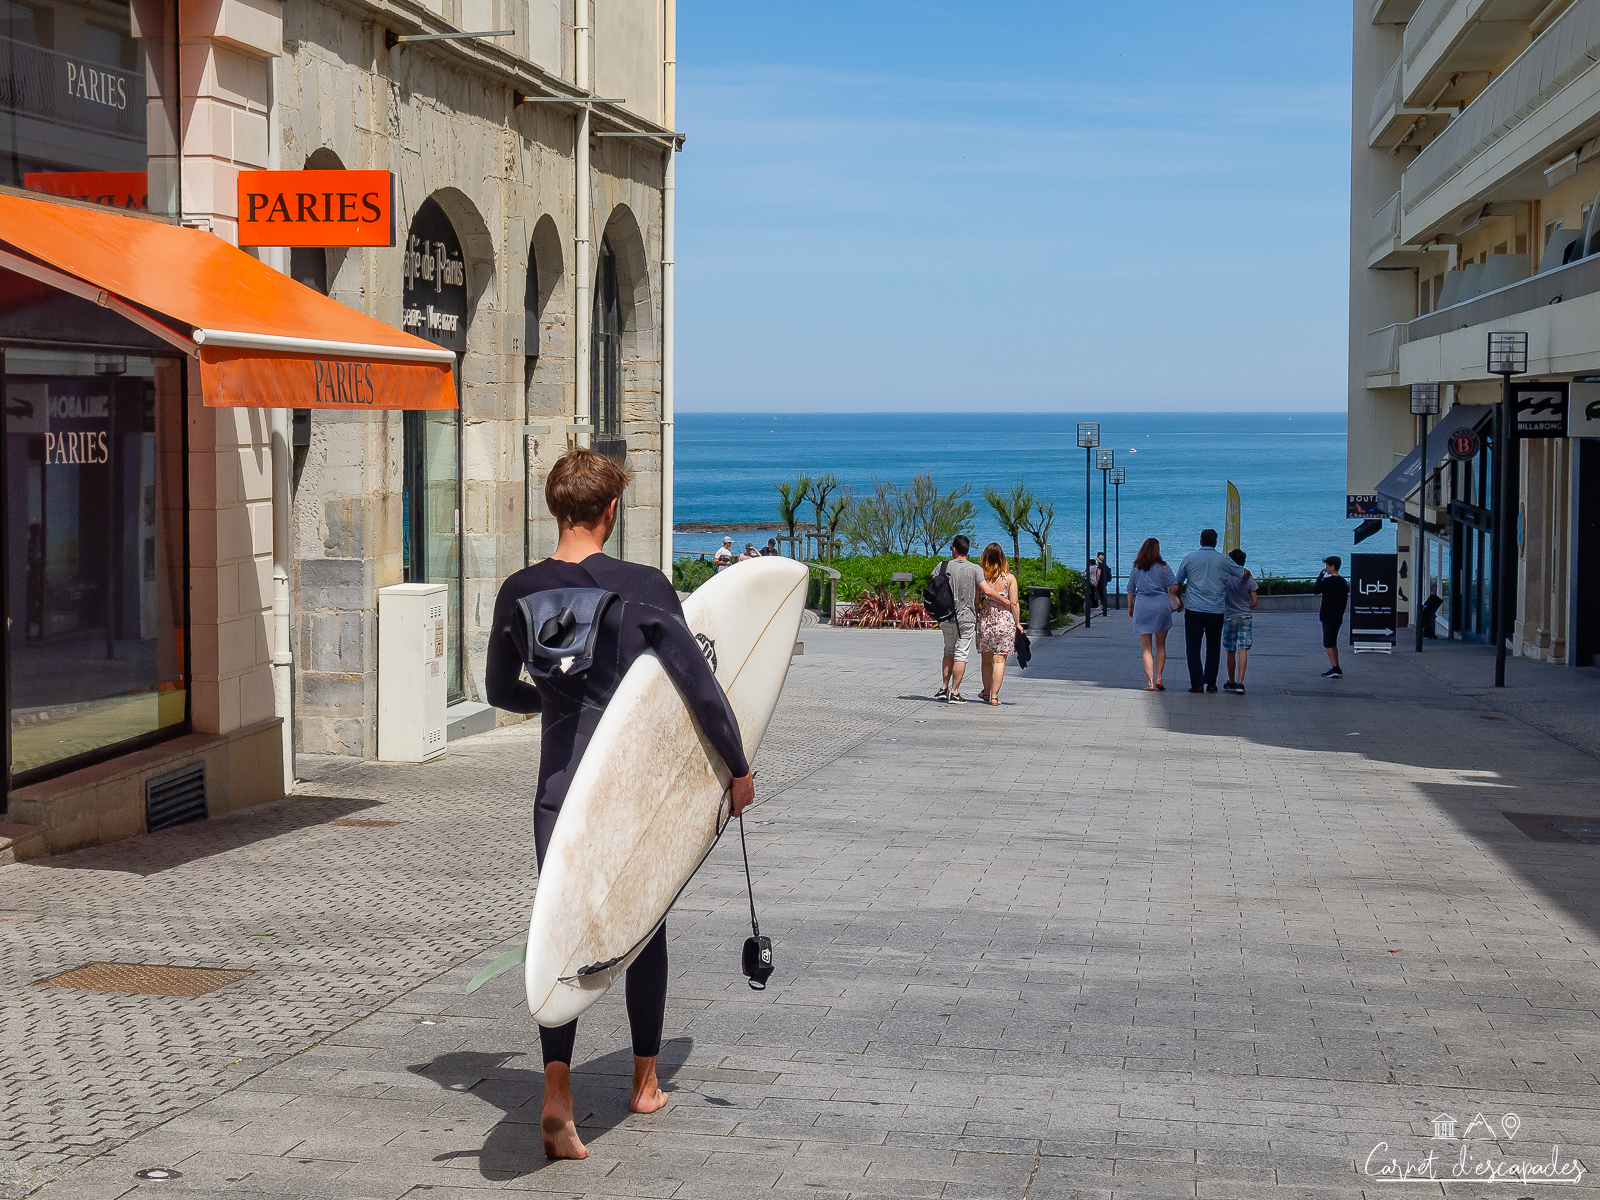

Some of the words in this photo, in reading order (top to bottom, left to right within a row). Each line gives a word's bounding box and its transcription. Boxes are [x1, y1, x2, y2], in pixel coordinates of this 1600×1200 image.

[66, 61, 127, 111] PARIES
[246, 192, 382, 223] PARIES
[404, 233, 421, 291] afé
[421, 239, 435, 282] de
[433, 241, 464, 294] Paris
[403, 303, 421, 327] serie
[313, 359, 375, 405] PARIES
[1517, 423, 1563, 431] BILLABONG
[44, 430, 109, 465] PARIES
[1457, 437, 1470, 453] B
